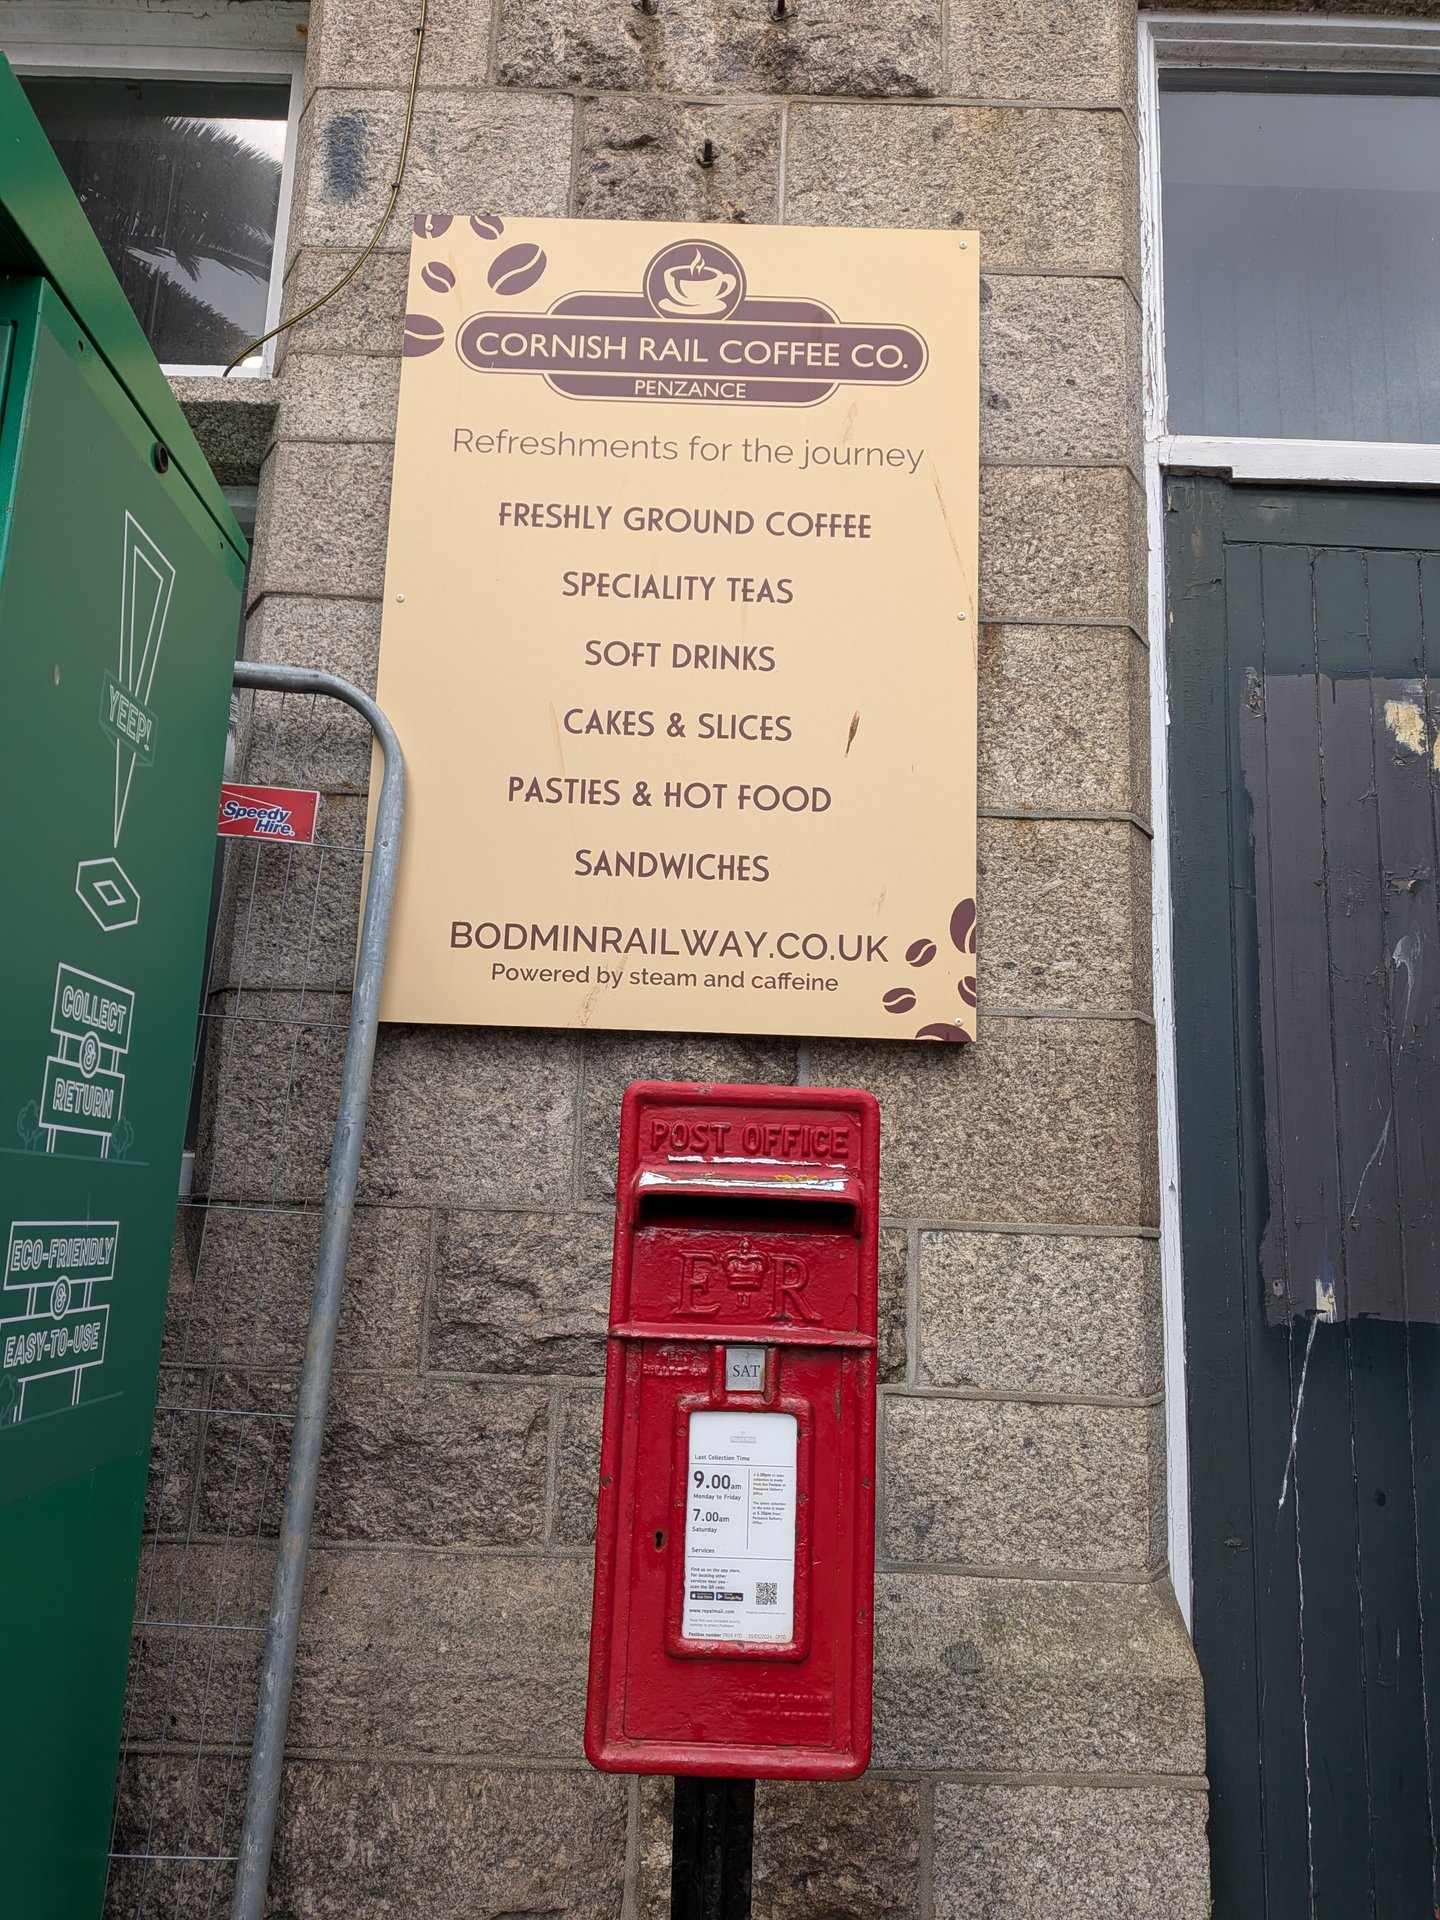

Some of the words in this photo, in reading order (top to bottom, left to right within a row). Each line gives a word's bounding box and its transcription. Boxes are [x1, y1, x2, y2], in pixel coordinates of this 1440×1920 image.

[475, 331, 627, 360] CORNISH
[639, 337, 708, 363] RAIL
[720, 339, 840, 367] COFFEE
[851, 344, 908, 369] CO.
[634, 379, 746, 399] PENZANCE
[453, 428, 679, 461] Refreshments
[689, 435, 731, 462] for
[742, 438, 793, 463] the
[799, 440, 925, 474] journey
[498, 502, 612, 530] FRESHLY
[623, 506, 754, 535] GROUND
[766, 511, 872, 539] COFFEE
[562, 572, 716, 601] SPECIALITY
[726, 578, 794, 604] TEAS
[585, 640, 661, 668] SOFT
[672, 644, 776, 672] DRINKS
[109, 684, 152, 751] YEEP!
[564, 708, 654, 737] CAKES
[666, 712, 686, 738] &
[698, 714, 793, 742] SLICES
[508, 777, 620, 806] PASTIES
[632, 781, 652, 806] &
[664, 782, 727, 810] HOT
[739, 784, 832, 812] FOOD
[224, 801, 291, 823] Speedy
[574, 849, 770, 881] SANDWICHES
[450, 921, 889, 963] BODMINRAILWAY.CO.UK
[491, 962, 590, 985] Powered
[595, 964, 623, 989] by
[629, 969, 697, 988] steam
[704, 969, 744, 988] and
[751, 971, 838, 992] caffeine
[62, 986, 126, 1034] COLLECT
[84, 1039, 96, 1070] &
[53, 1078, 114, 1119] RETURN
[651, 1120, 730, 1152] POST
[742, 1124, 850, 1158] OFFICE
[10, 1237, 114, 1271] ECO-FRIENDLY
[54, 1283, 66, 1313] &
[673, 1249, 720, 1317] E
[765, 1254, 822, 1323] R
[4, 1322, 100, 1368] EASY-TO-USE
[732, 1364, 760, 1377] SAT
[693, 1509, 729, 1522] 7.00am
